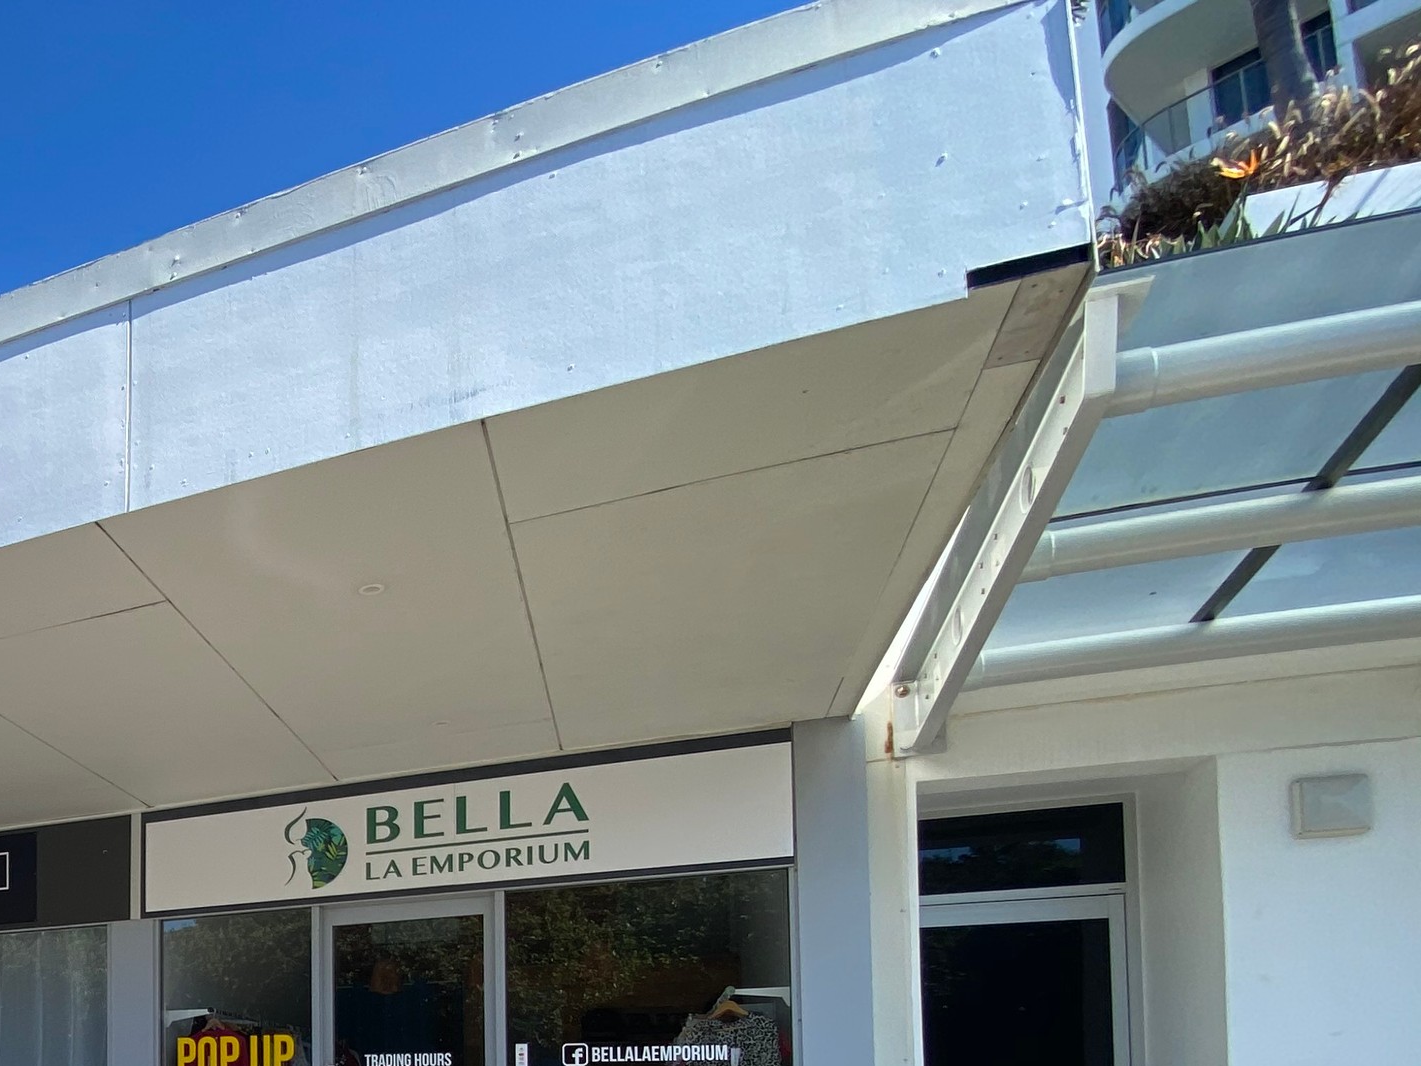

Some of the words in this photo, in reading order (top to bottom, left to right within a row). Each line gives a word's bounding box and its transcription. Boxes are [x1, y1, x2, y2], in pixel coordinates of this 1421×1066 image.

[366, 782, 590, 845] BELLA
[365, 859, 403, 881] LA
[412, 840, 590, 876] EMPORIUM
[364, 1053, 411, 1066] TRADING
[414, 1052, 452, 1066] HOURS
[591, 1044, 728, 1063] BELLALAEMPORIUM
